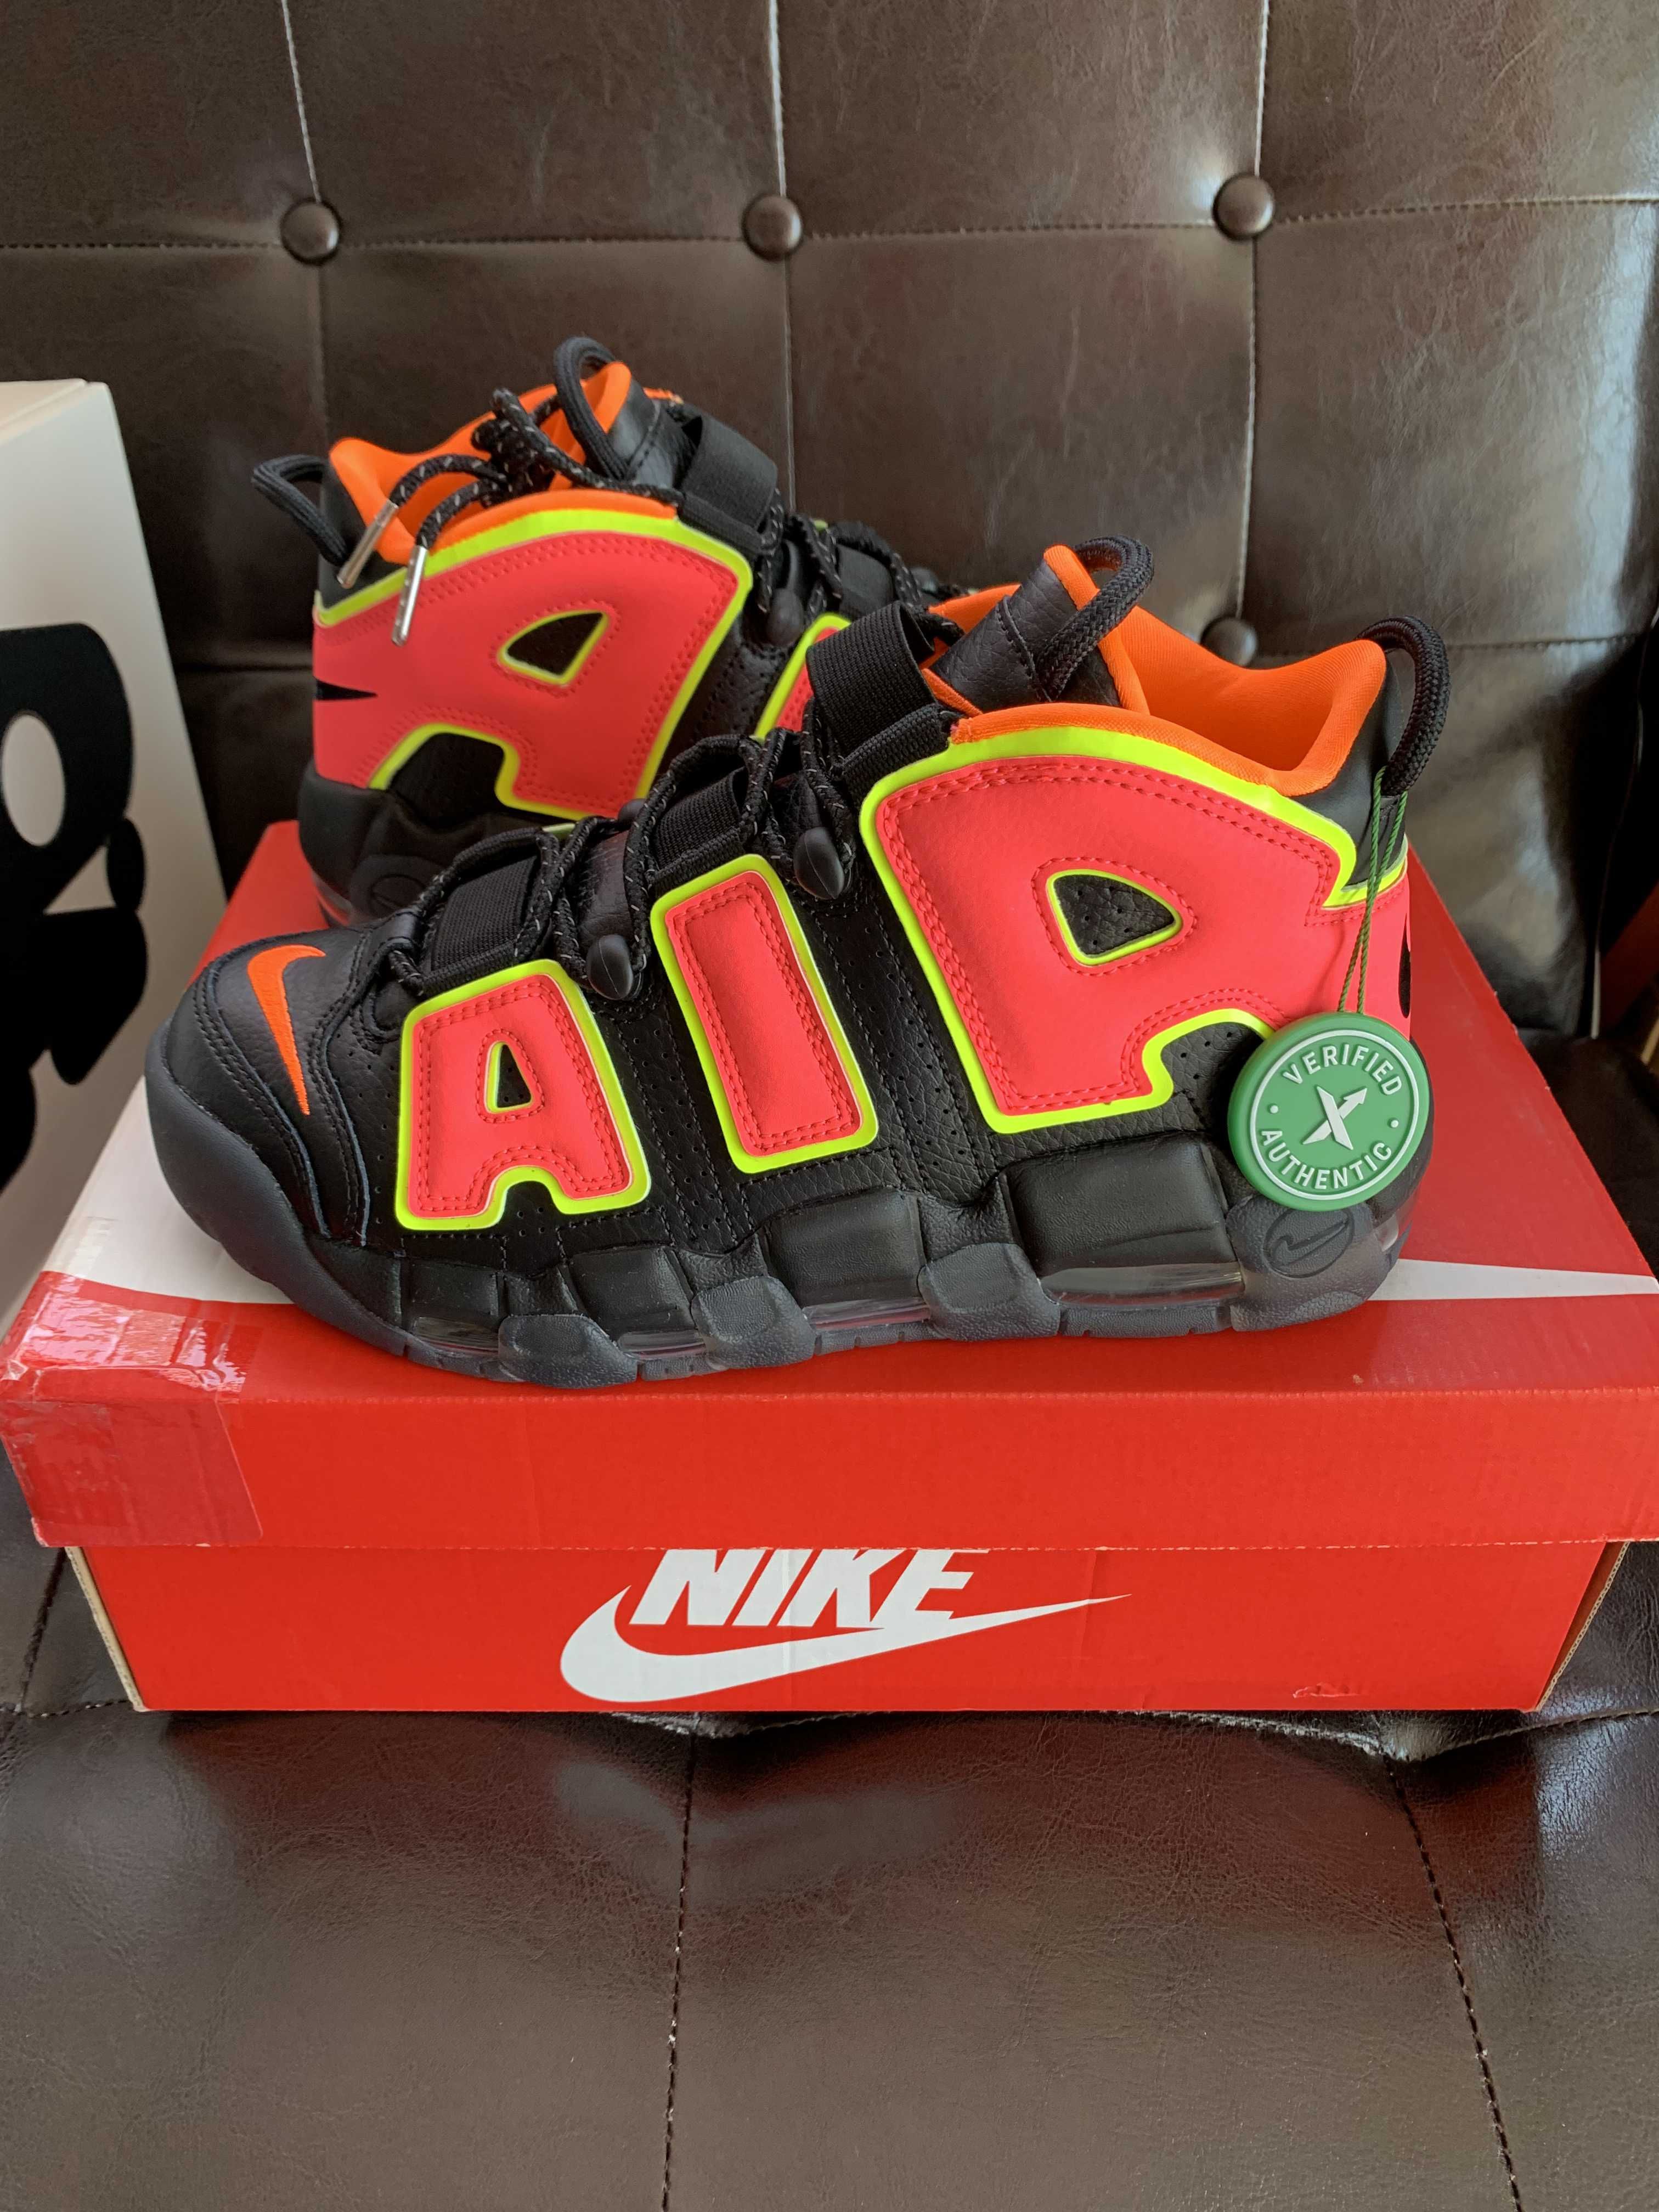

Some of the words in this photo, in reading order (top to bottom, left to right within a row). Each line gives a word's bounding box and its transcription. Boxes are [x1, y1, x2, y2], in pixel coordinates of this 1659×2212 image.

[1282, 1044, 1402, 1096] VERIFIED
[1261, 1130, 1392, 1189] AUTHENTIC
[629, 1548, 989, 1628] NIKE
